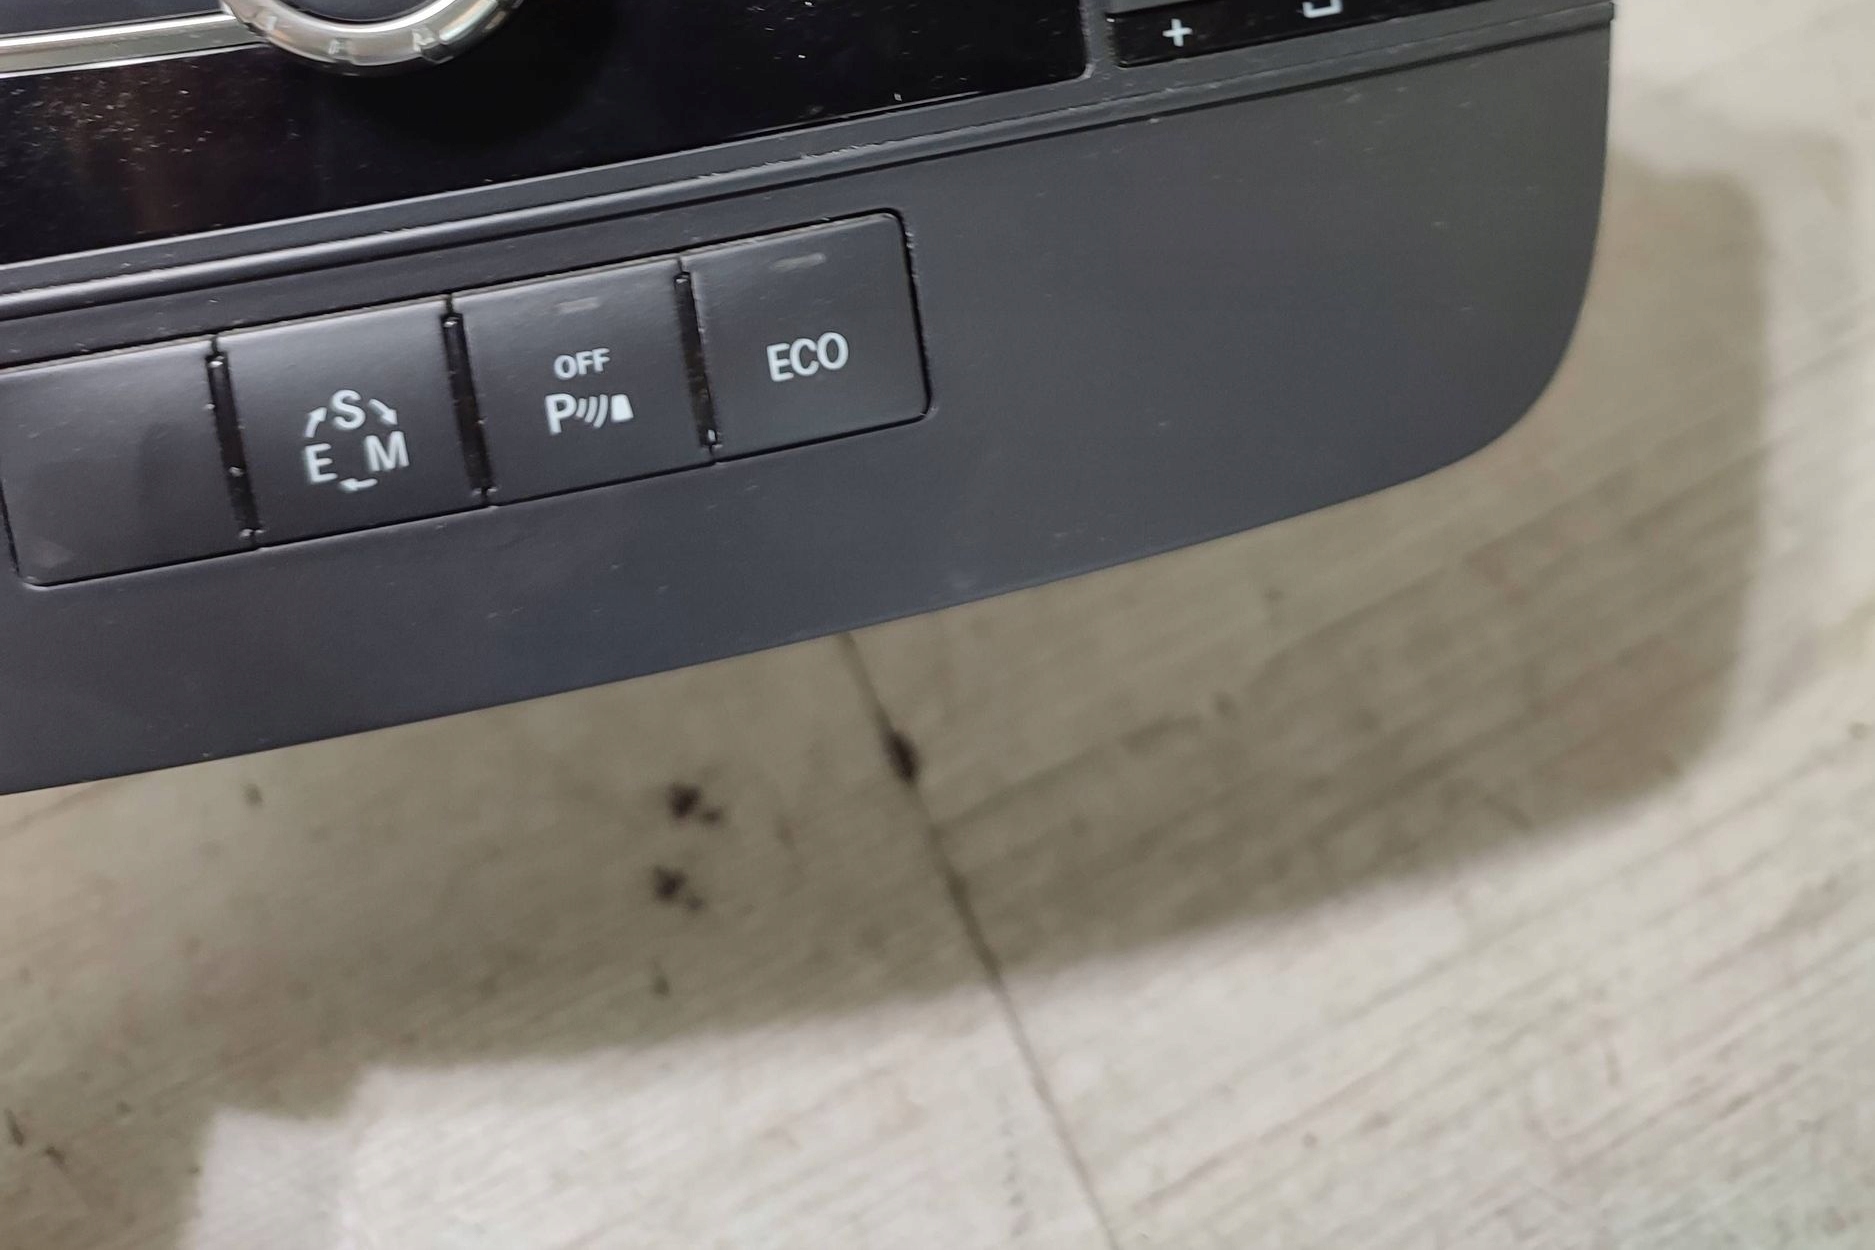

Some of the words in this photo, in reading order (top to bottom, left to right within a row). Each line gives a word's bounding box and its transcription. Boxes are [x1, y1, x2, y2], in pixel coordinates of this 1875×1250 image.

[553, 347, 609, 378] OFF
[766, 332, 848, 381] ECO
[331, 389, 365, 429] S
[304, 443, 336, 482] E
[365, 430, 409, 471] M
